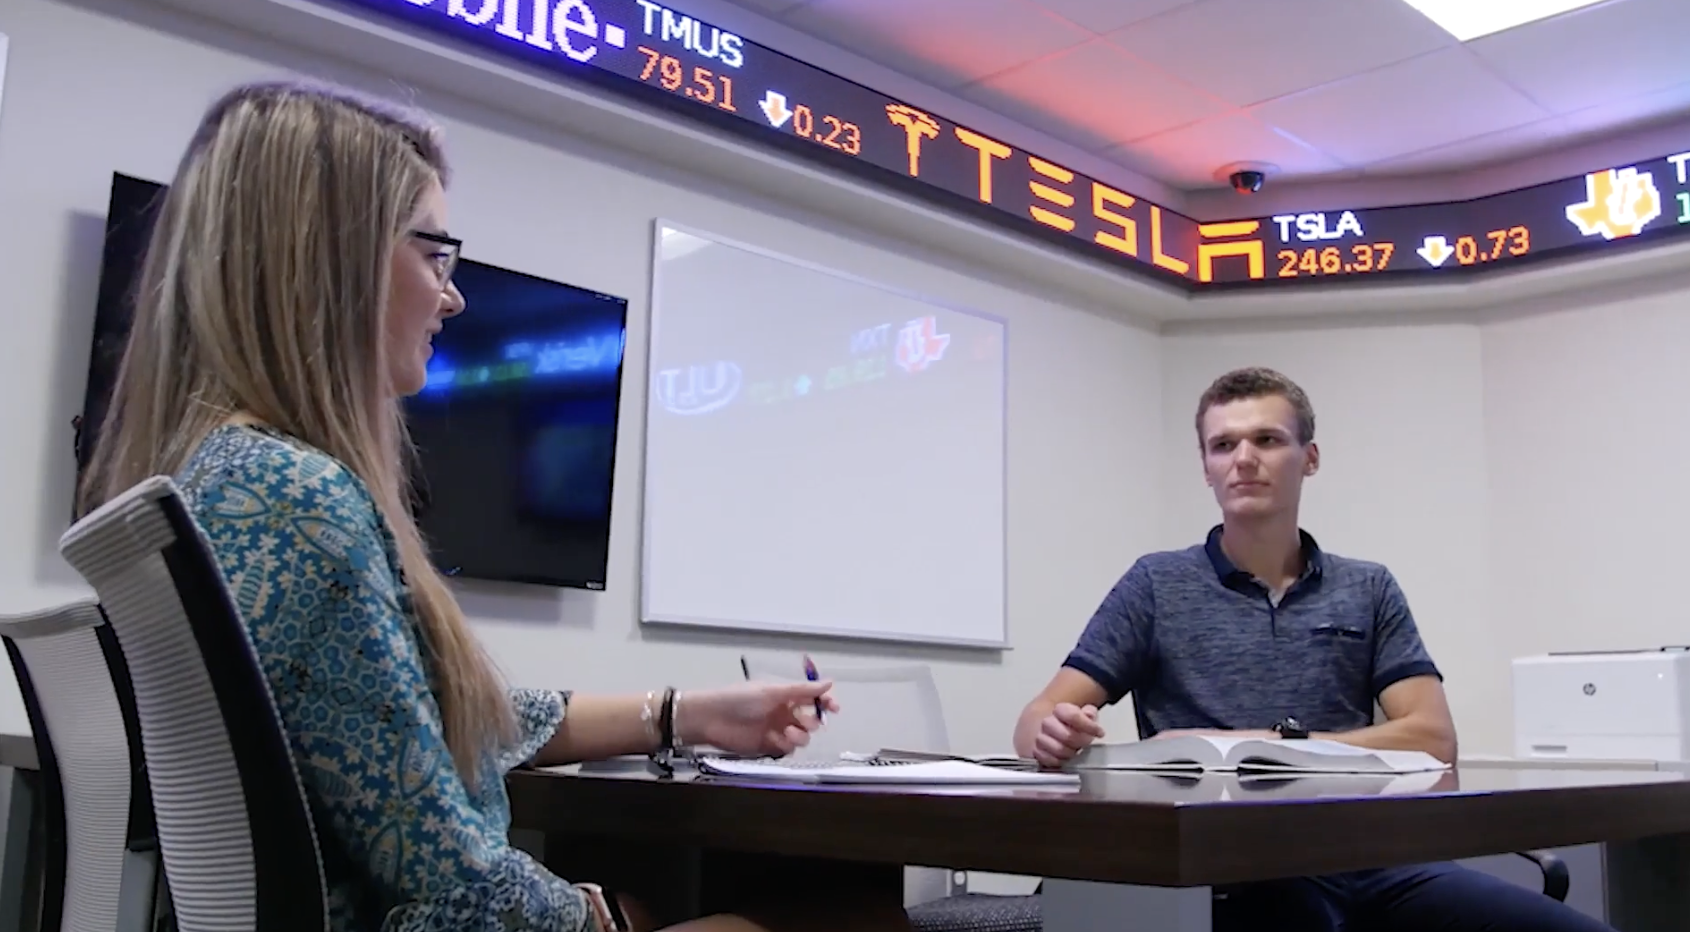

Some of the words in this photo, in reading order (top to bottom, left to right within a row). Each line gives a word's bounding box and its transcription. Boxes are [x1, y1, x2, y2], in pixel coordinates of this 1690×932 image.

[636, 0, 743, 68] TMUS
[638, 46, 736, 112] 79.51
[793, 105, 861, 155] 0.23
[954, 126, 1264, 282] TESLA
[1273, 211, 1363, 242] TSLA
[1276, 242, 1394, 278] 246.37
[1455, 226, 1530, 265] 0.73
